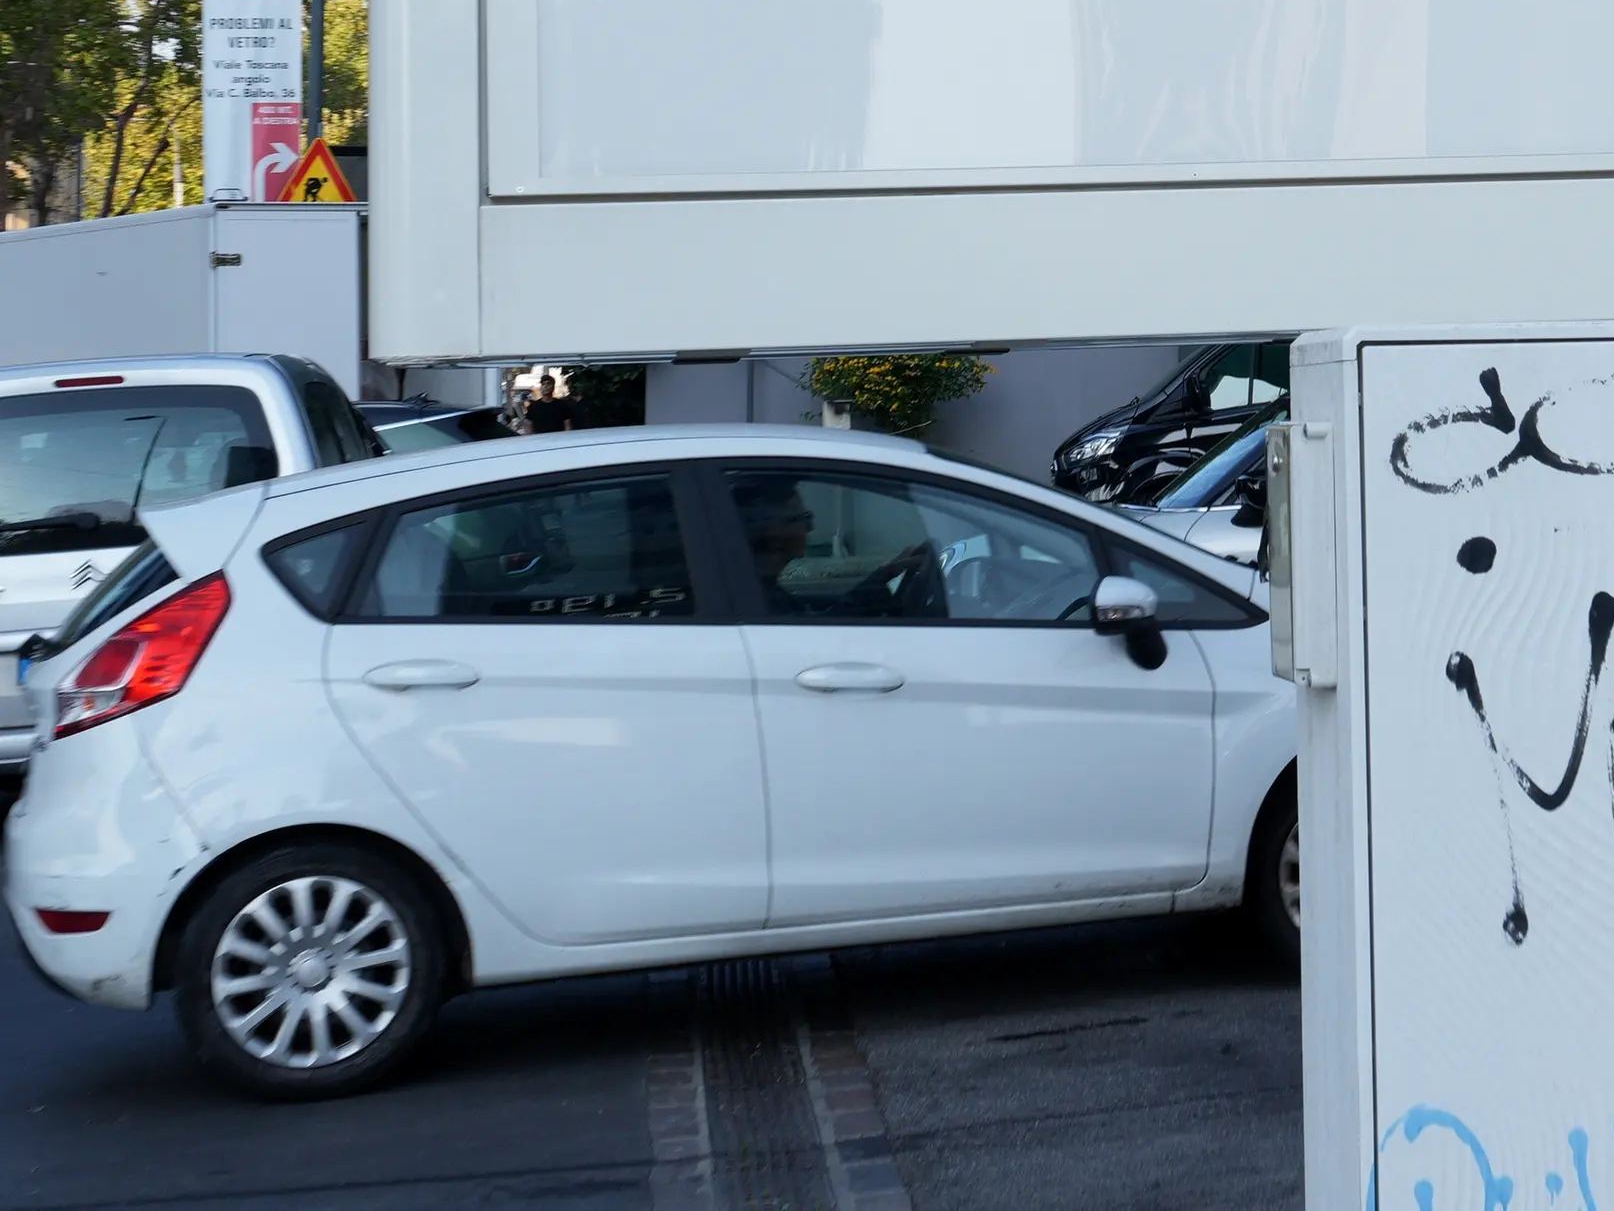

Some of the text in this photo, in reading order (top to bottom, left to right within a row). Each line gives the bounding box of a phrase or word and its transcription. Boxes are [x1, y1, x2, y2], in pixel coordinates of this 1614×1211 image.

[209, 18, 294, 30] PROBLEMI AL
[227, 36, 276, 49] VETRO?
[212, 59, 289, 70] Viale Toscana
[231, 75, 271, 86] angolo
